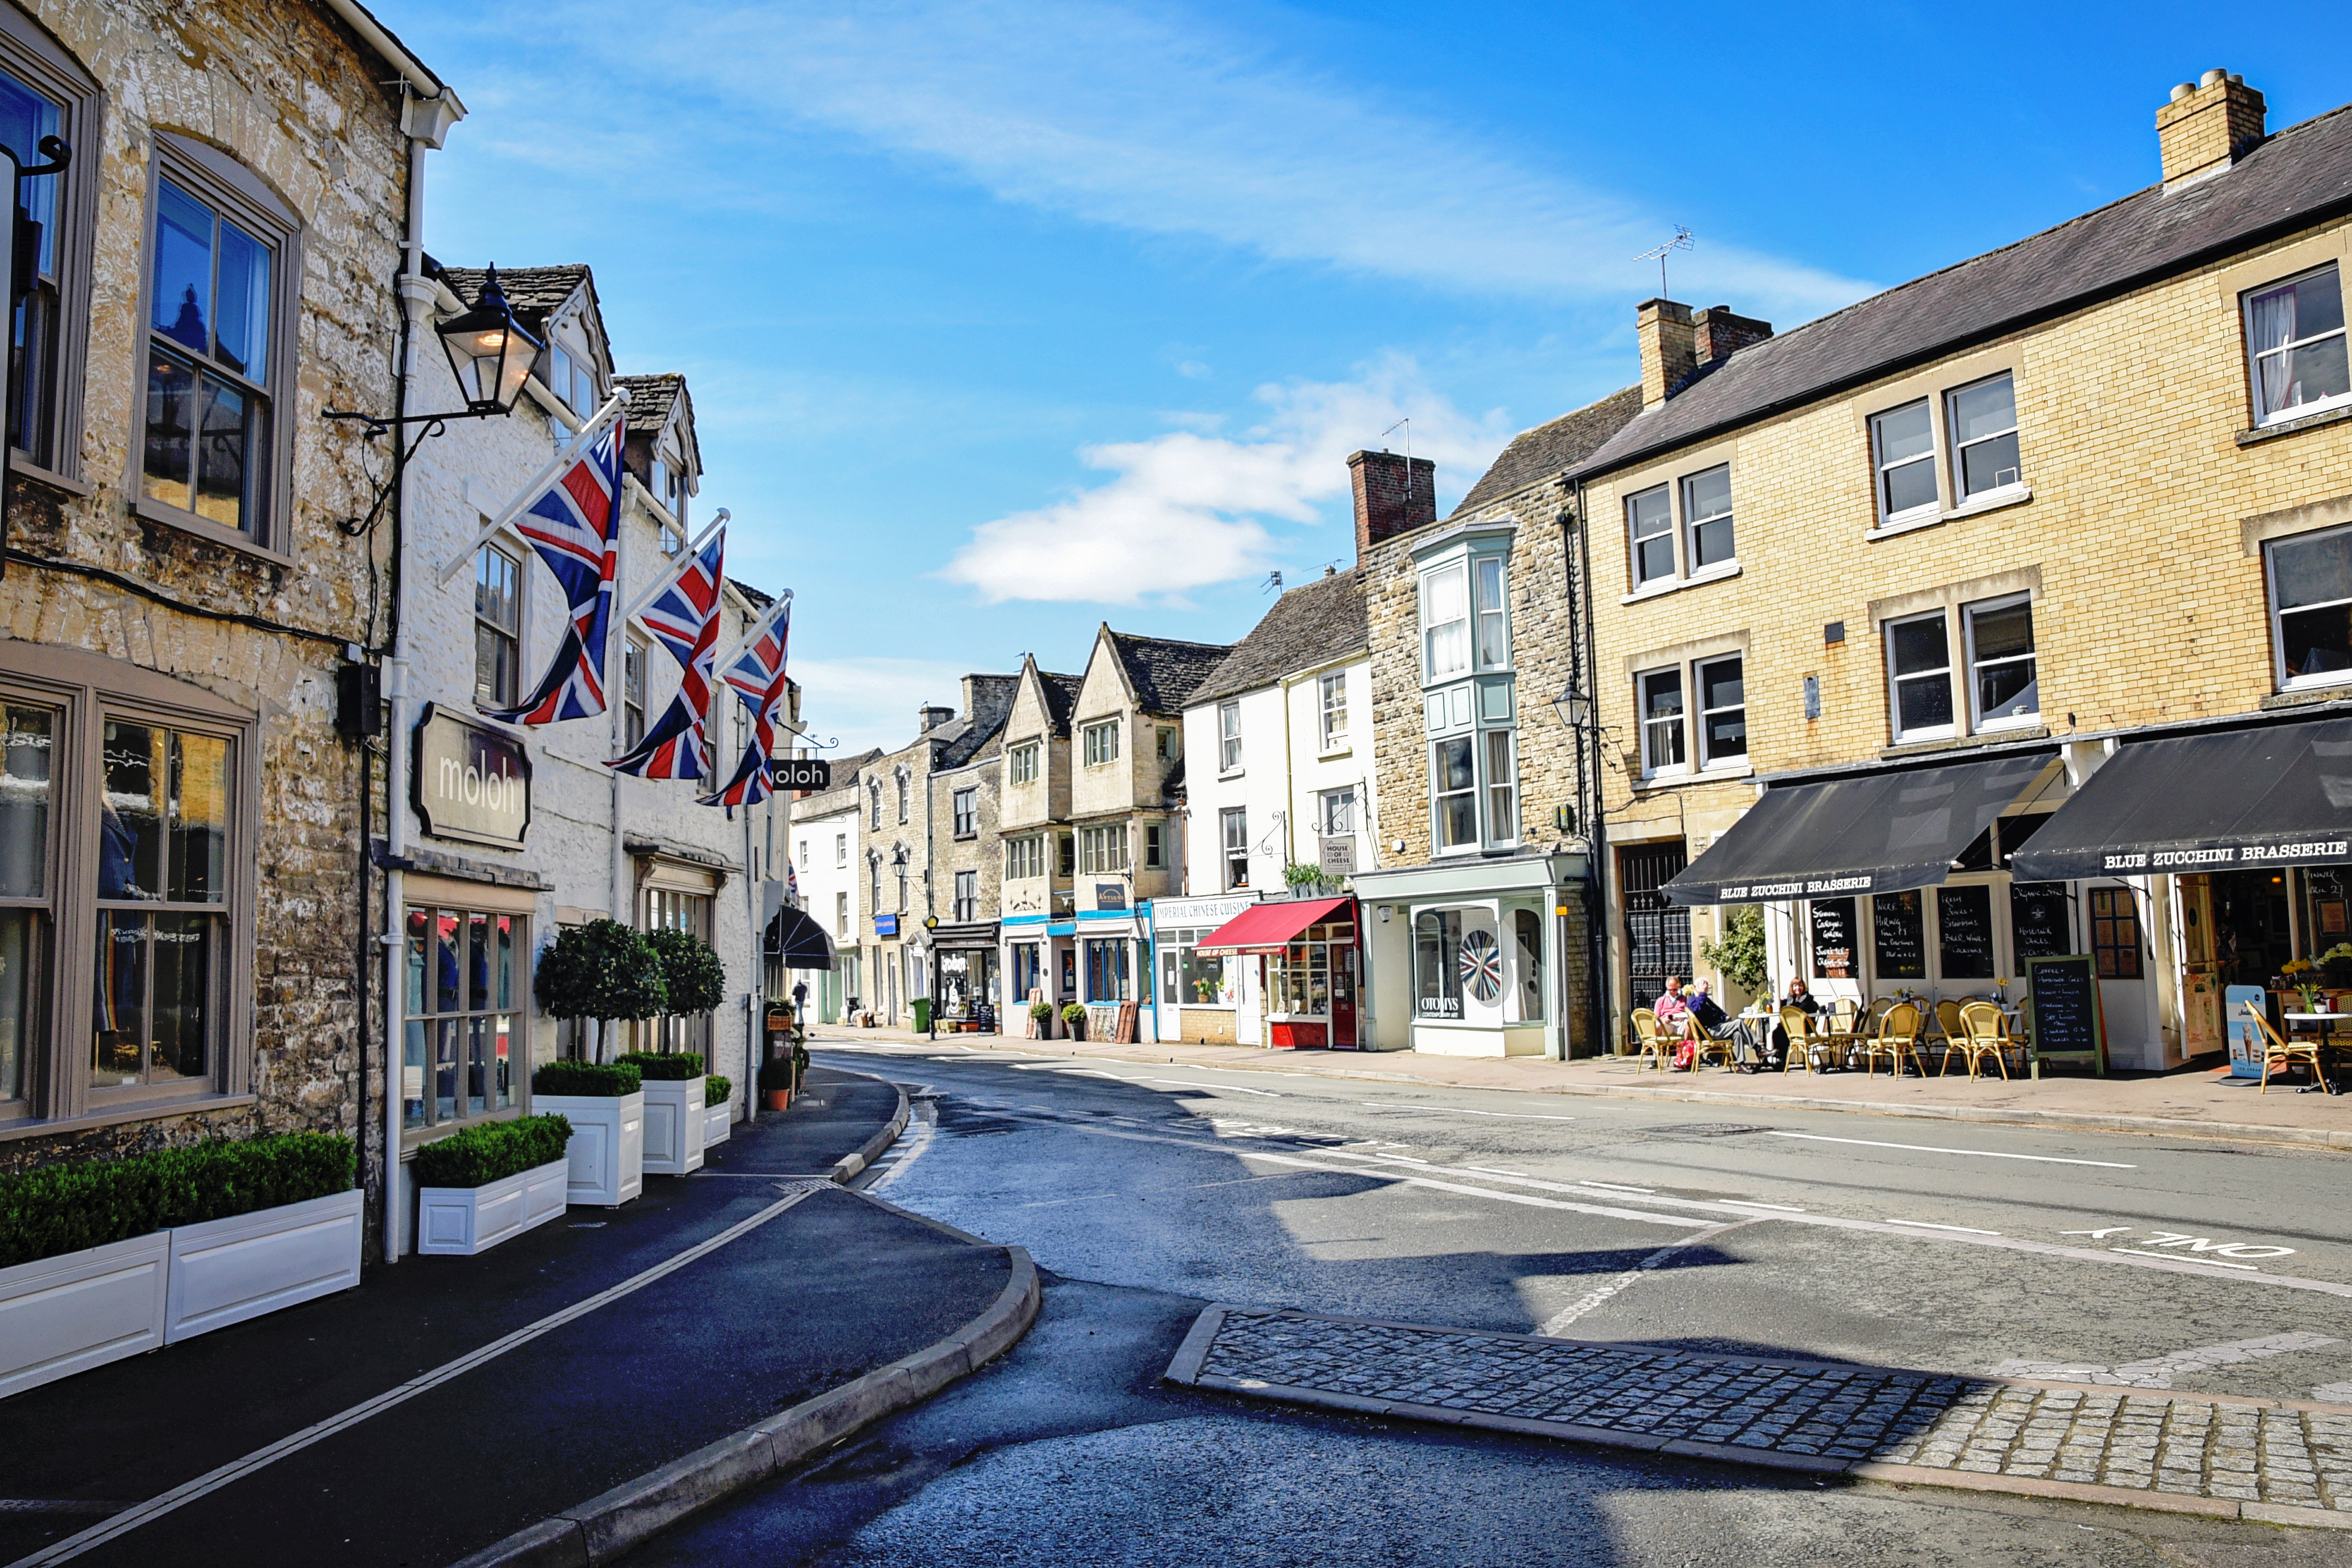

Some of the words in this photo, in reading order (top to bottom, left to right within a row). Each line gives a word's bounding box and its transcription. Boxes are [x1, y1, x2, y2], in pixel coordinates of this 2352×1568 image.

[439, 749, 514, 814] moloh
[771, 764, 823, 783] oloh
[2104, 854, 2146, 869] BLUE
[2153, 849, 2234, 866] ZUCCHINI
[2240, 841, 2347, 861] BRASSERIE
[1720, 887, 1748, 899] BLUE
[1751, 883, 1803, 896] ZUCCHINI
[1806, 876, 1872, 893] BRASSERIE
[1156, 905, 1188, 918] IMPERIAL
[1189, 904, 1218, 917] CHINESE
[1220, 901, 1250, 915] CUISINE
[2060, 1227, 2295, 1257] ONLY
